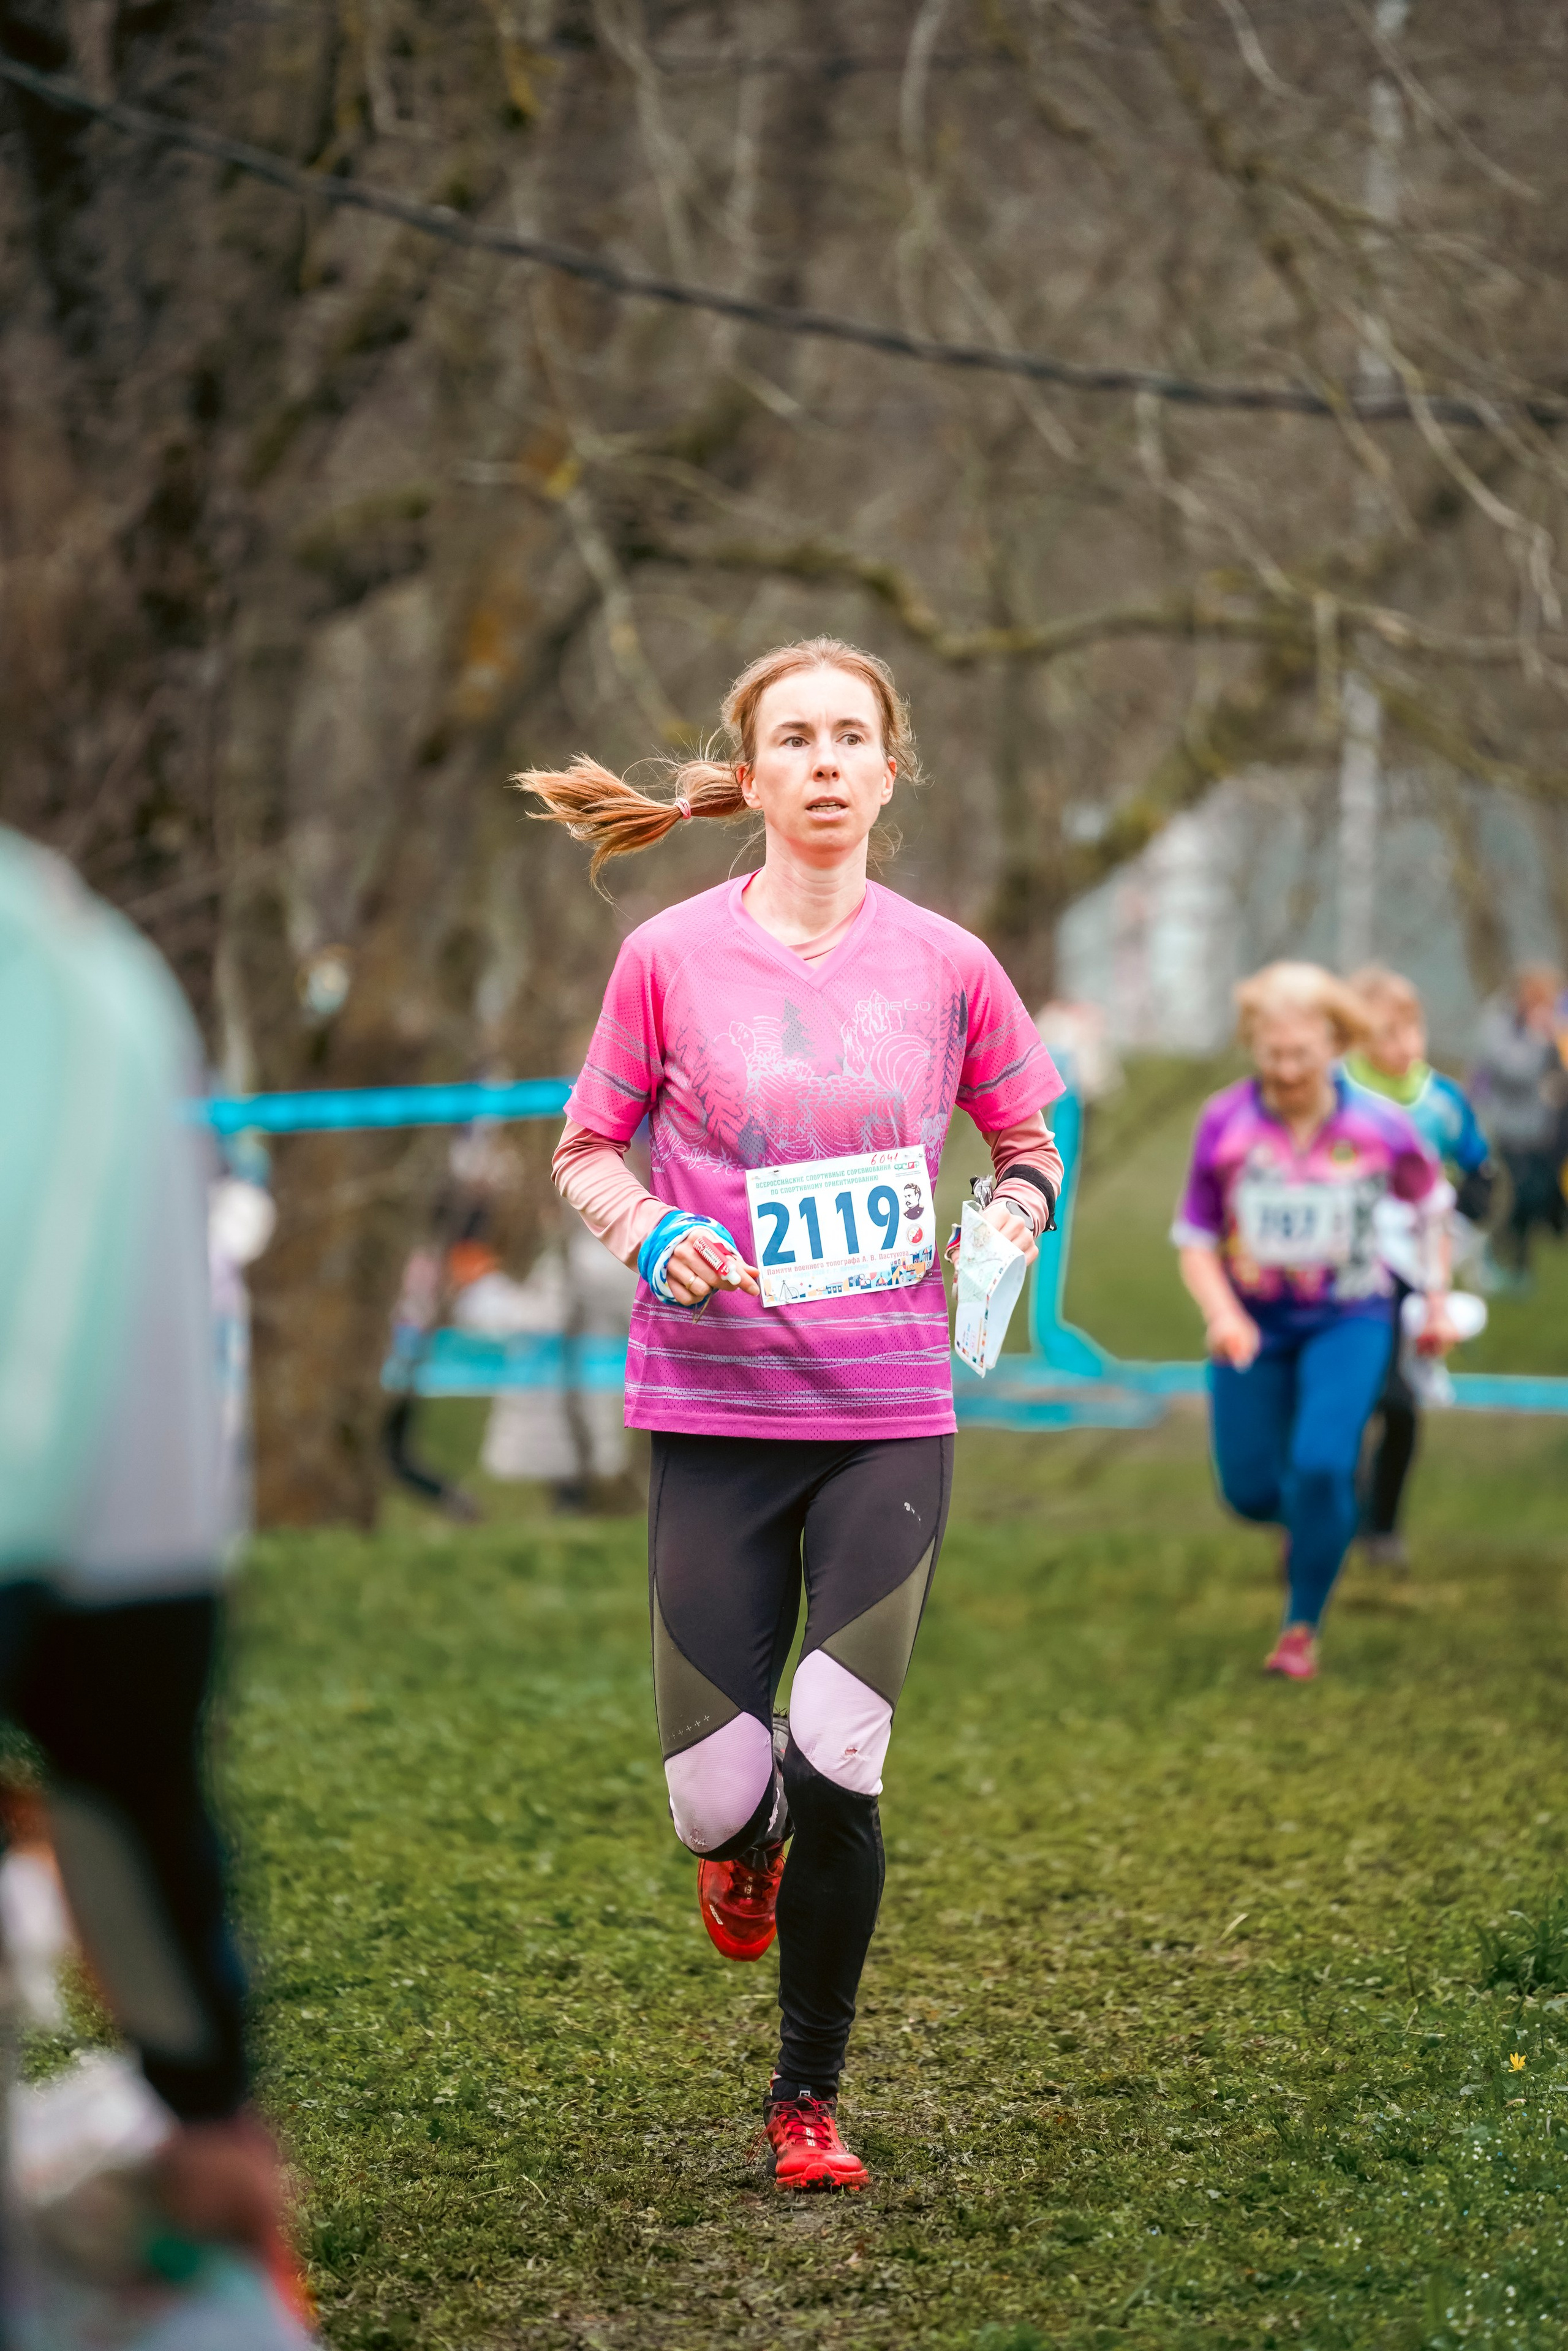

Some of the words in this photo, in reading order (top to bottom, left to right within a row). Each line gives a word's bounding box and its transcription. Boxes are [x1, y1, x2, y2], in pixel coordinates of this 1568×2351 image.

[756, 1176, 804, 1188] ВСЕРОССИЙСКИЕ
[806, 1171, 845, 1182] СПОРТИВНЫЕ
[847, 1164, 891, 1176] СОРЕВНОВАНИЯ
[780, 1183, 823, 1194] СПОРТИВНОМУ
[825, 1175, 878, 1188] ОРИЕНТИРОВАНИЮ
[757, 1185, 899, 1266] 2119
[767, 1267, 792, 1275] Памяти
[794, 1262, 824, 1272] военного
[826, 1257, 860, 1268] топографа
[879, 1250, 909, 1260] Пастухова
